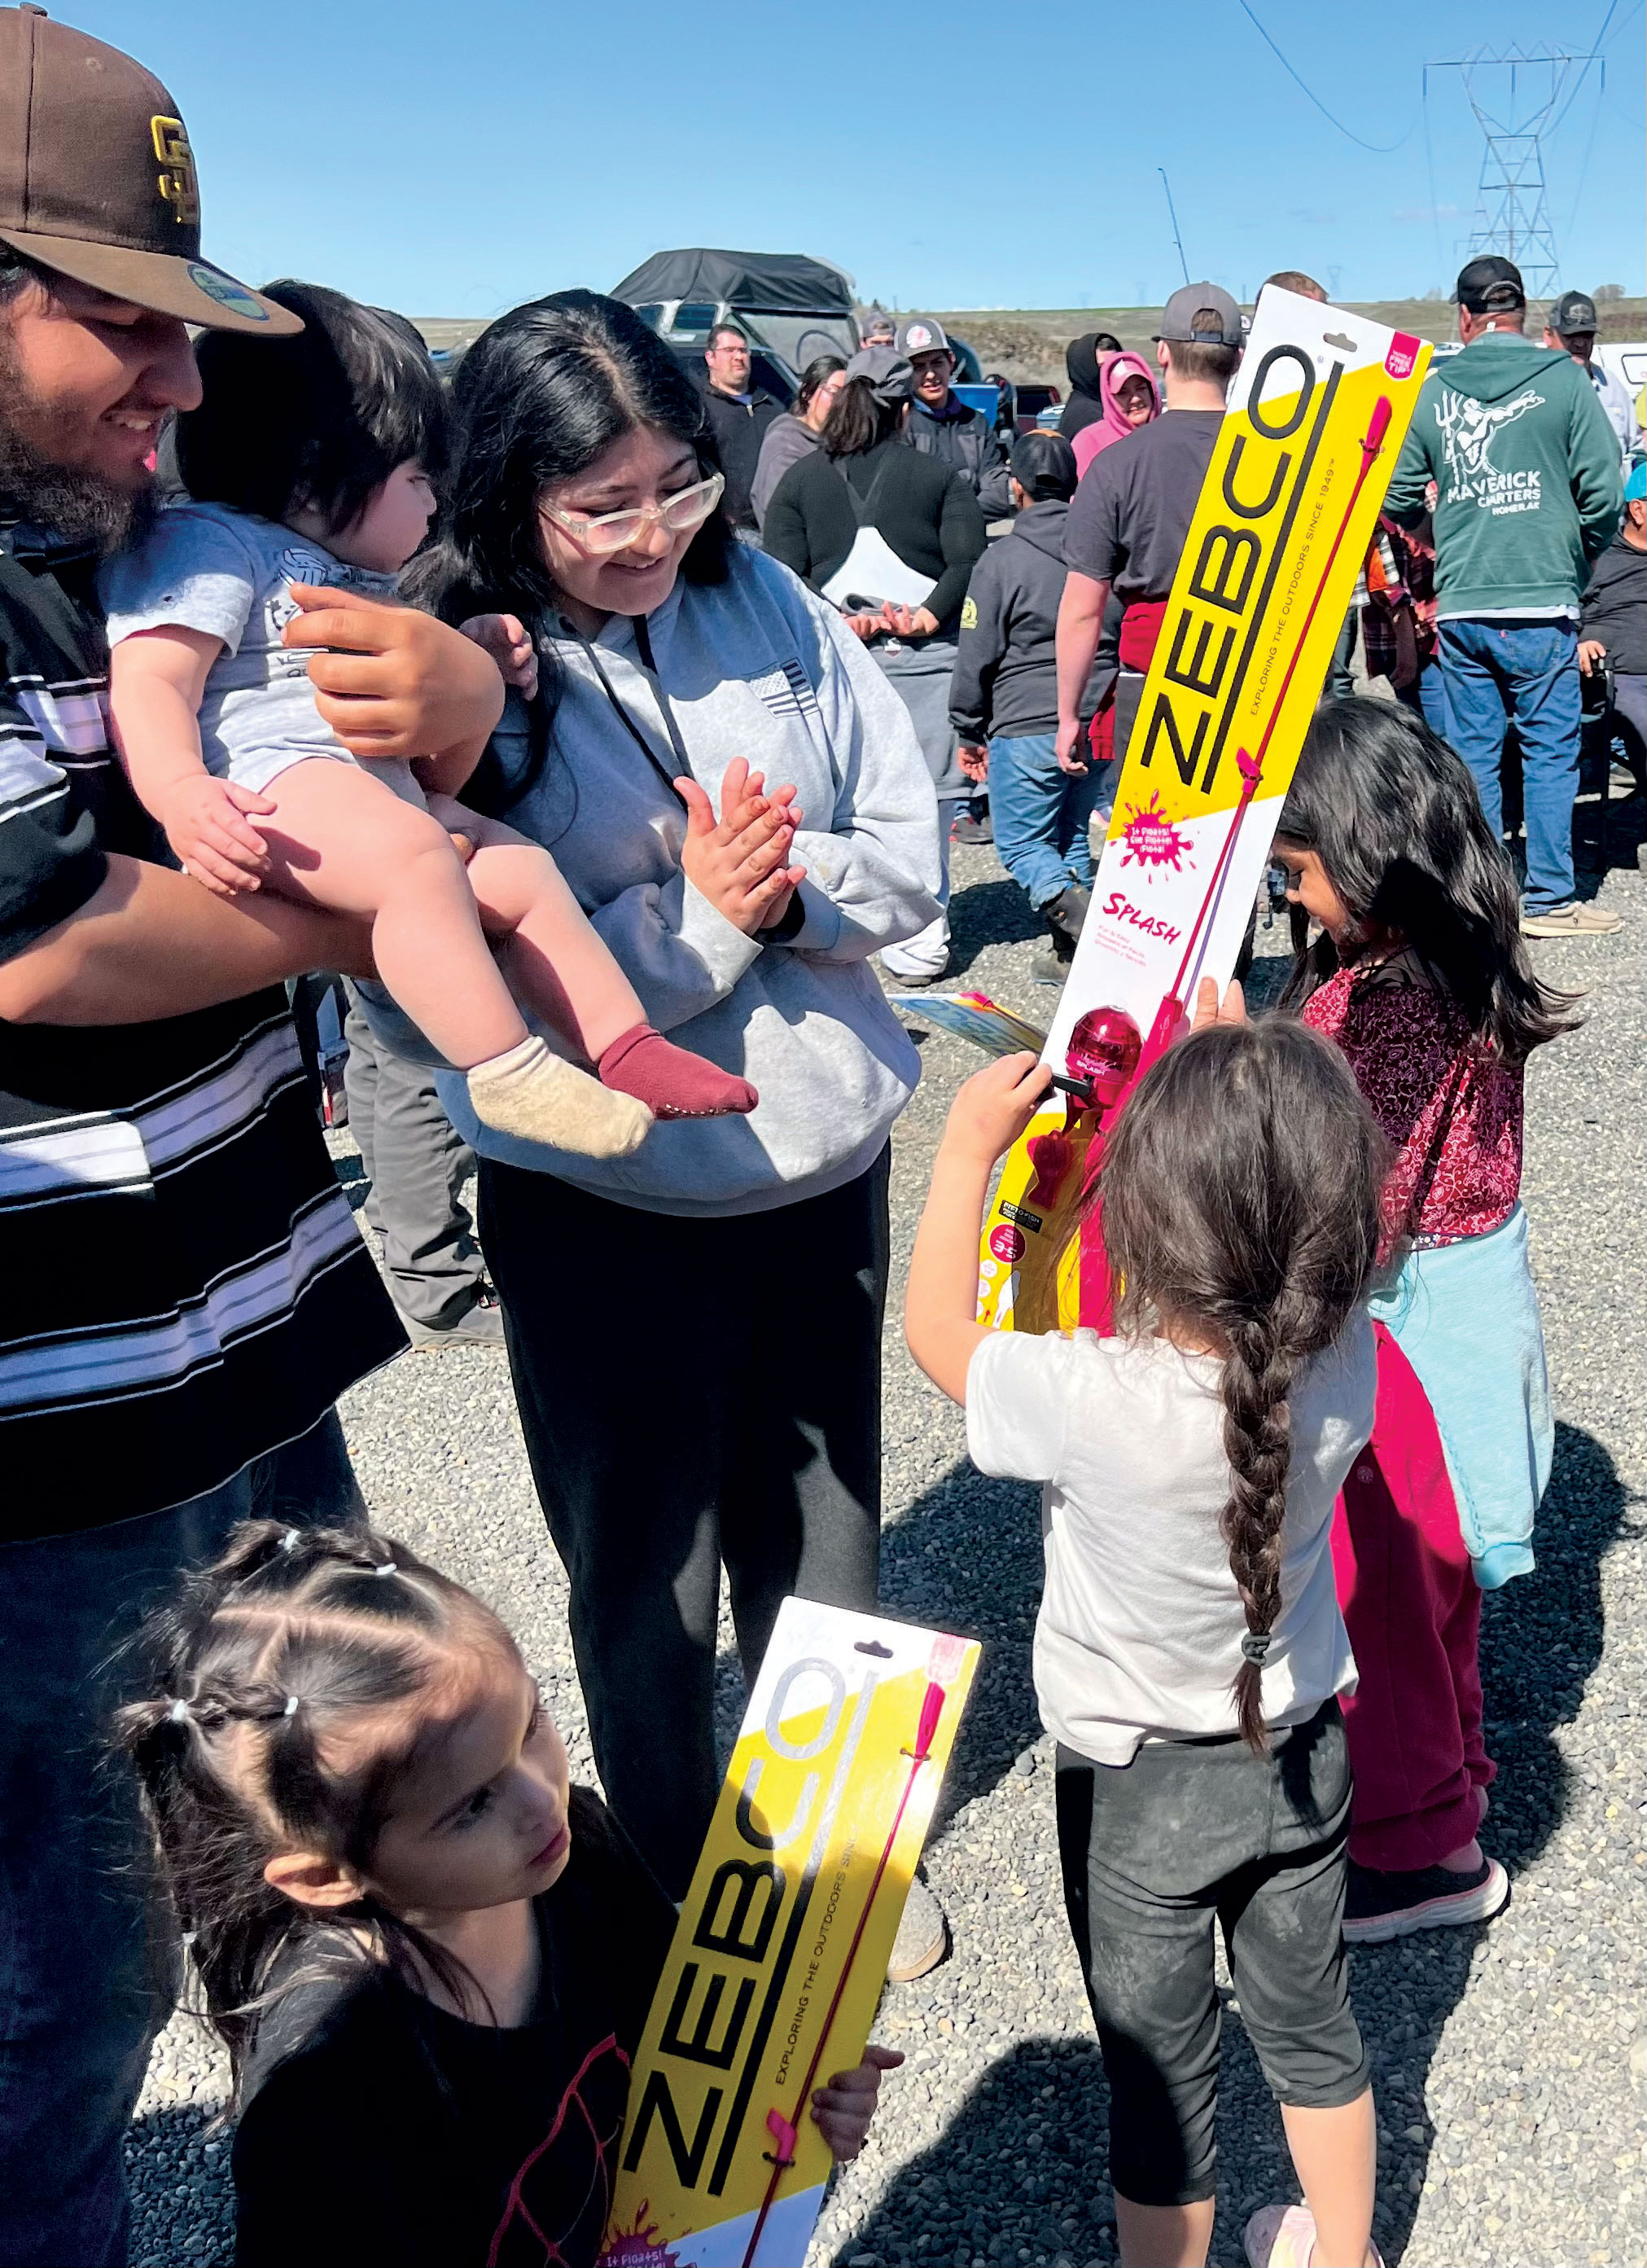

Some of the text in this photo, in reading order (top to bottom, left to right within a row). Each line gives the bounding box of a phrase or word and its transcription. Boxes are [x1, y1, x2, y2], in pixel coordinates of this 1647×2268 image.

[1141, 344, 1316, 787] ZEBCO
[1447, 471, 1541, 504] MAVERICK
[1251, 647, 1277, 715] EXPLORING
[1272, 619, 1287, 642] THE
[1282, 544, 1310, 615] OUTDOORS
[1306, 502, 1323, 541] SINCE
[623, 1656, 846, 2191] ZEBCO
[775, 1995, 809, 2086] EXPLORING
[803, 1961, 820, 1991] THE
[813, 1871, 846, 1956] OUTDOORS
